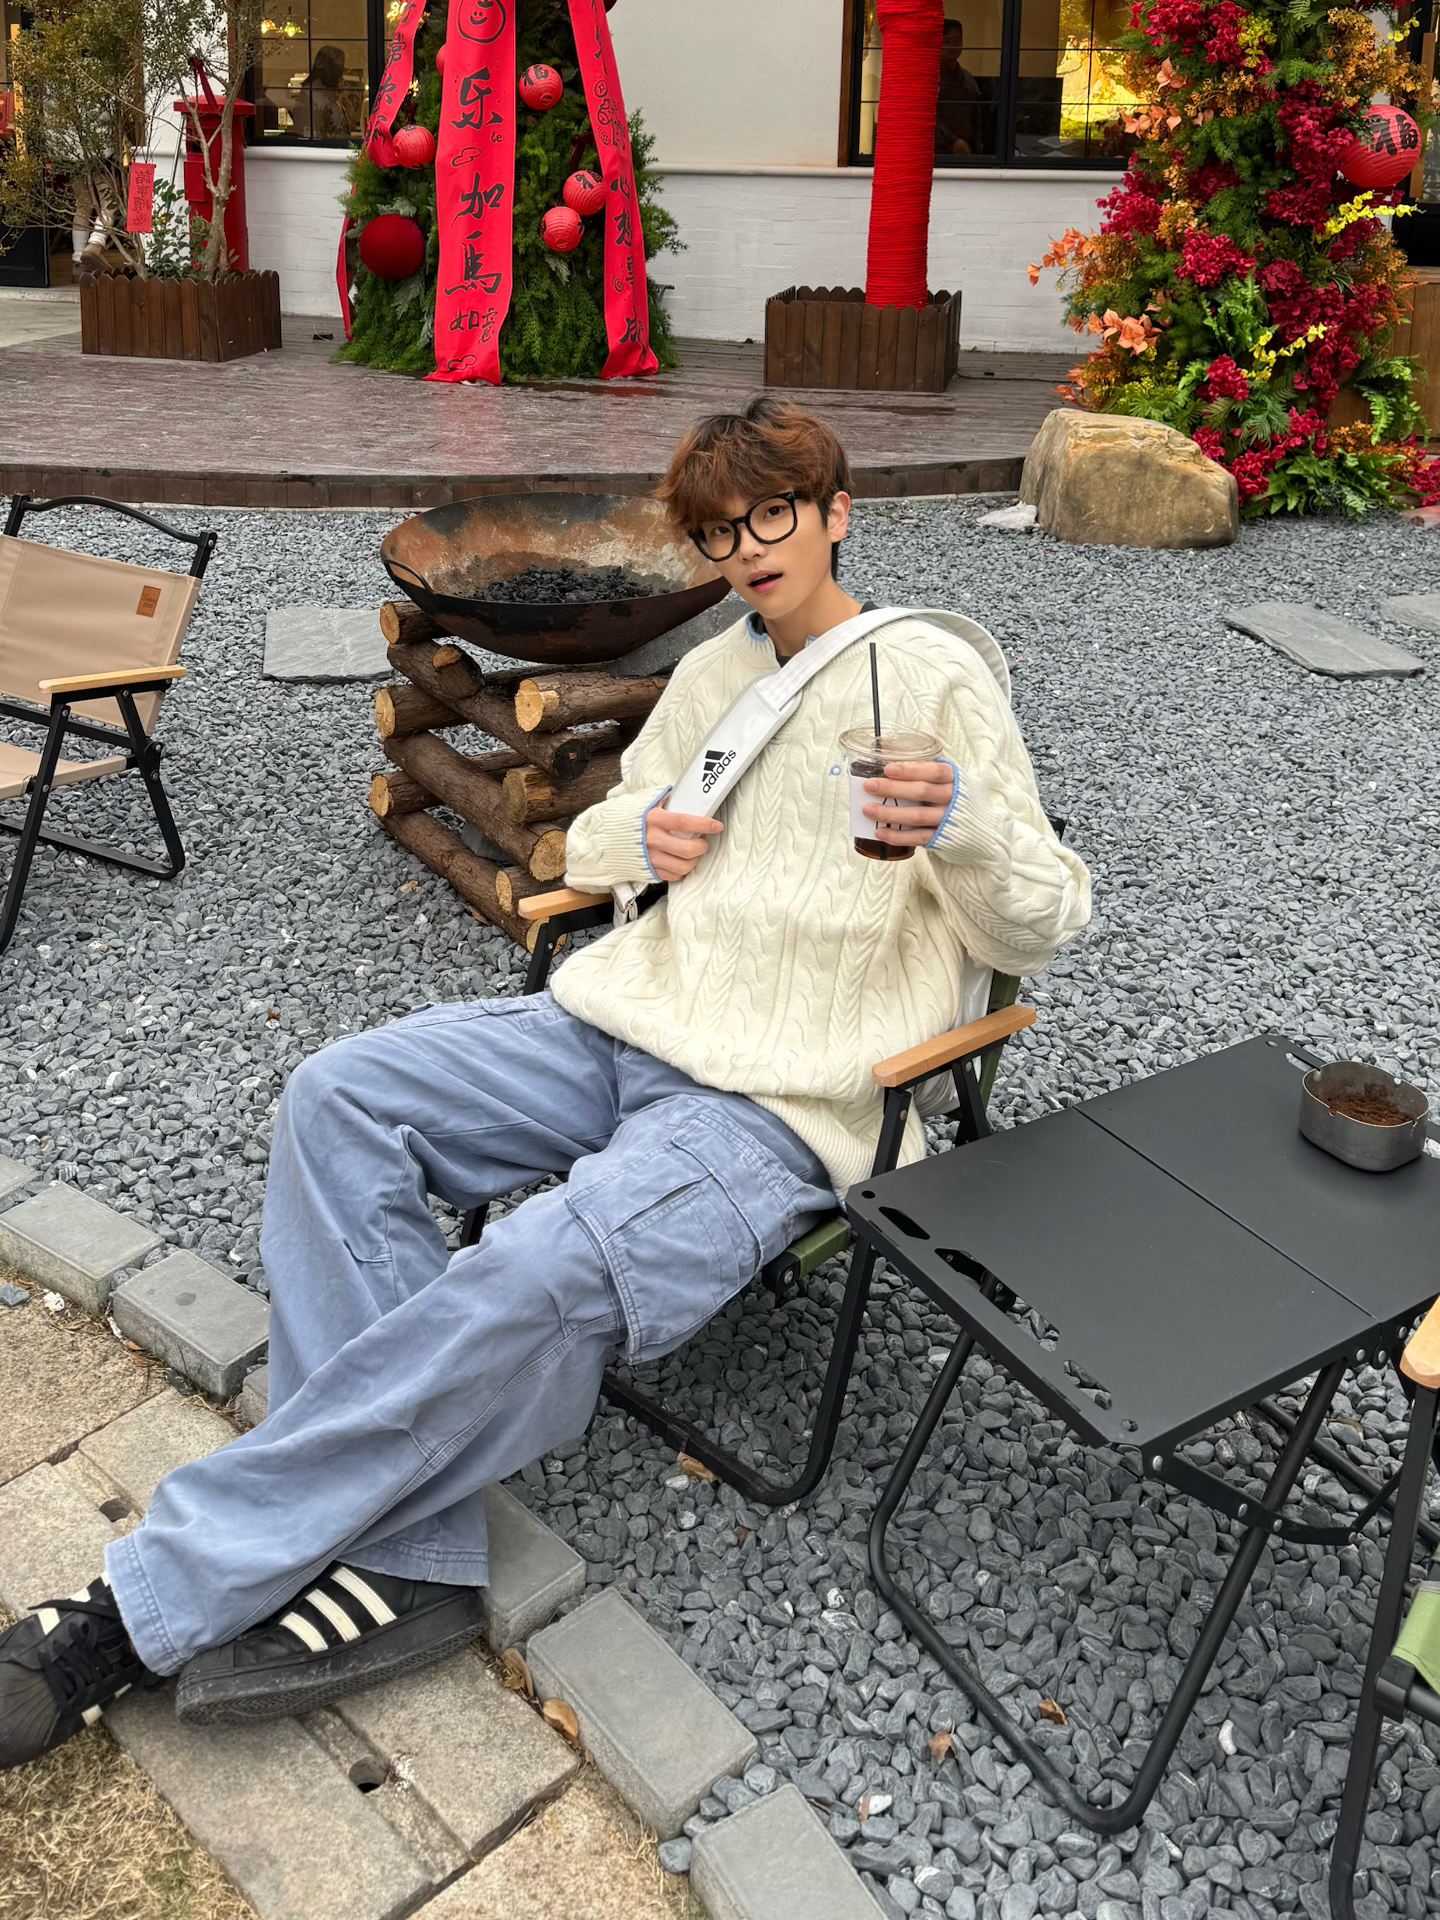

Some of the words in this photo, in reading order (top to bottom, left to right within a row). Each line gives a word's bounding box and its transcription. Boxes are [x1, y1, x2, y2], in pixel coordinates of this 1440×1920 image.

[1368, 114, 1418, 156] 福
[450, 307, 498, 344] 如意
[702, 749, 737, 794] adidas
